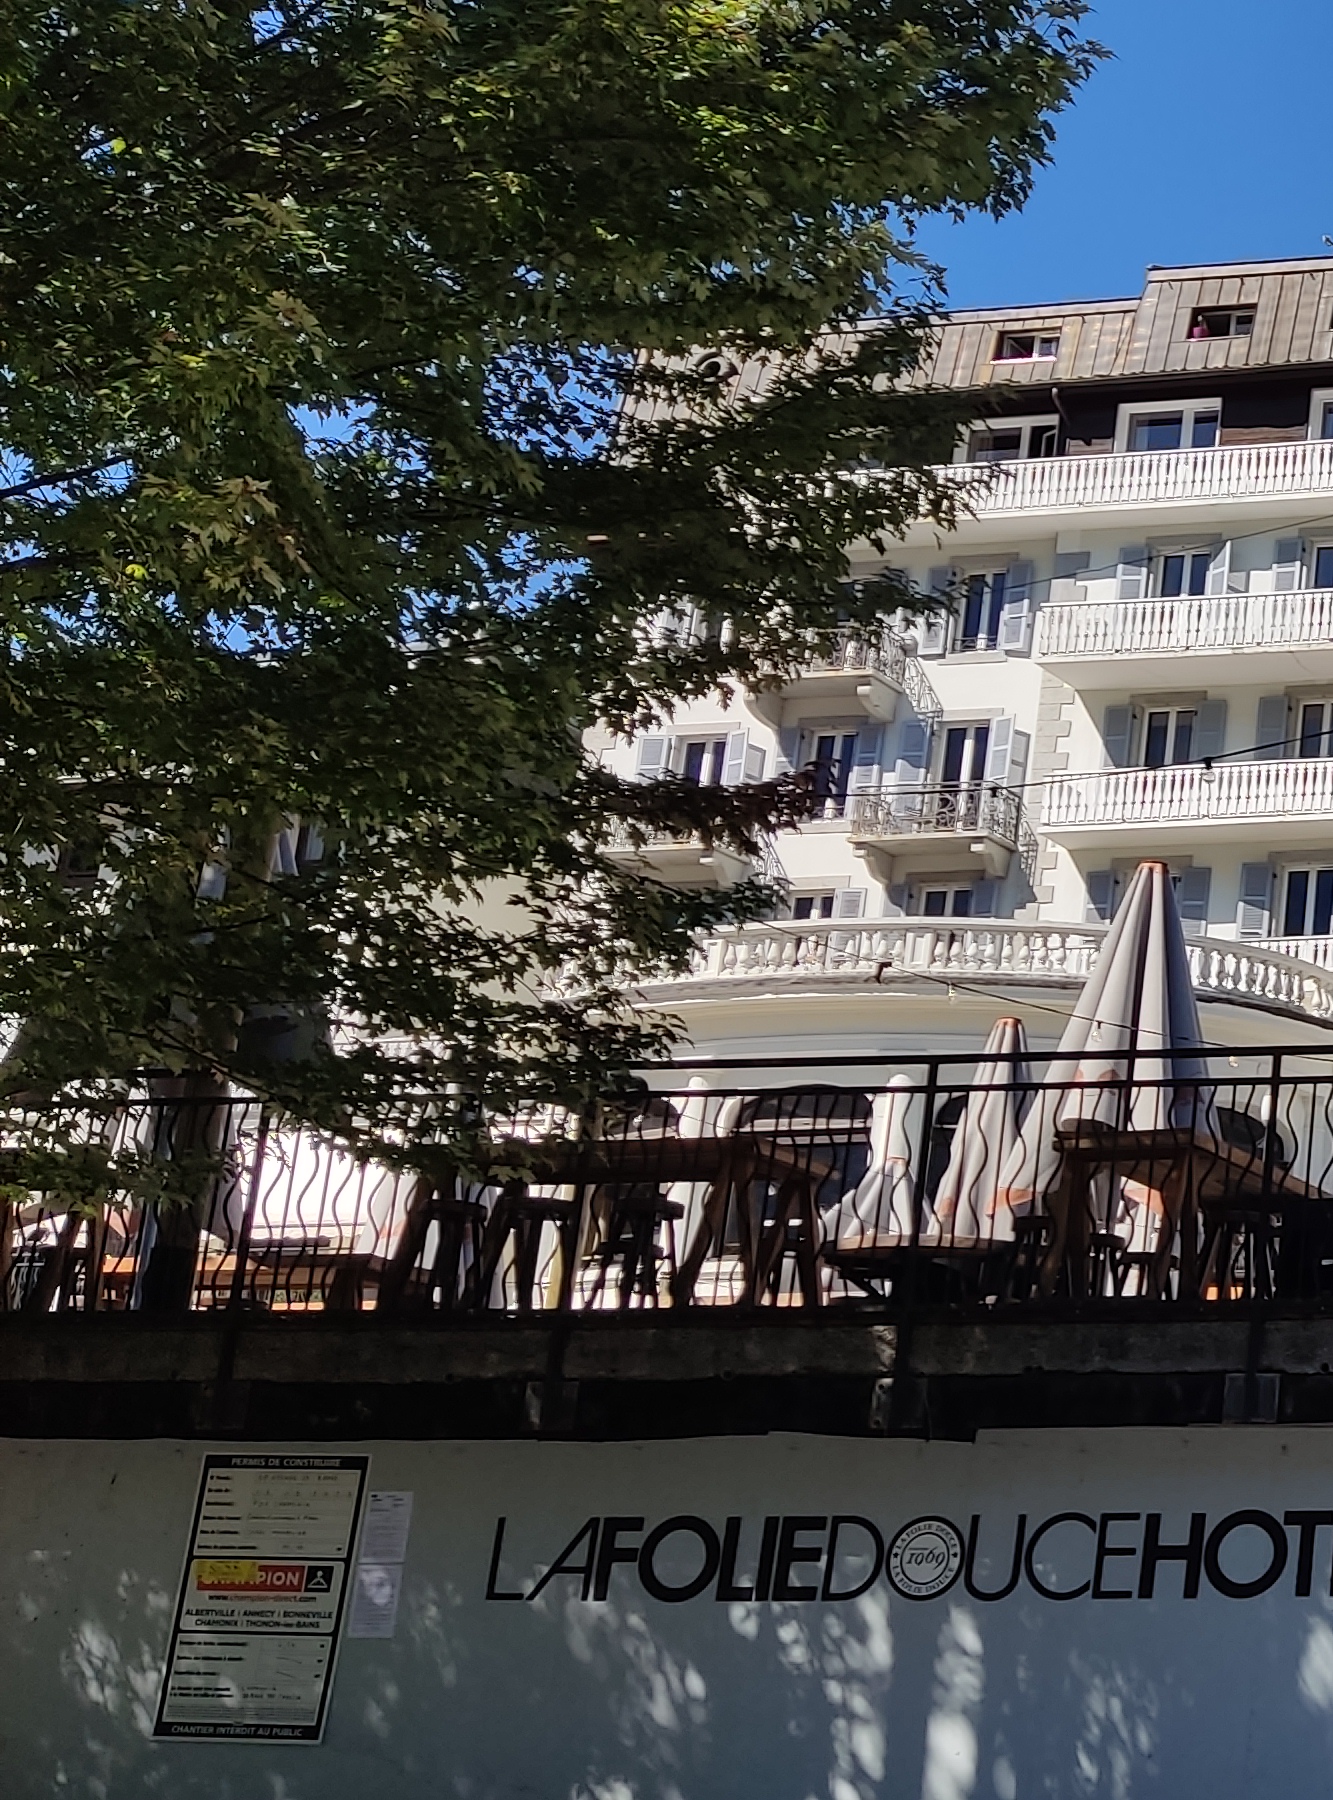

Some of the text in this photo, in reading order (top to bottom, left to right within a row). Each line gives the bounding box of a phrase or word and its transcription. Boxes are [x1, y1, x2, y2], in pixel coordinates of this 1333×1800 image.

[231, 1457, 266, 1467] PERMIS
[267, 1458, 281, 1467] DE
[184, 1608, 334, 1619] ALBERTVILLE ANNECY BONNEVILLE
[194, 1618, 239, 1628] CHAMONIX
[171, 1724, 304, 1737] CHANTIER INTERDIT AU PUBLIC
